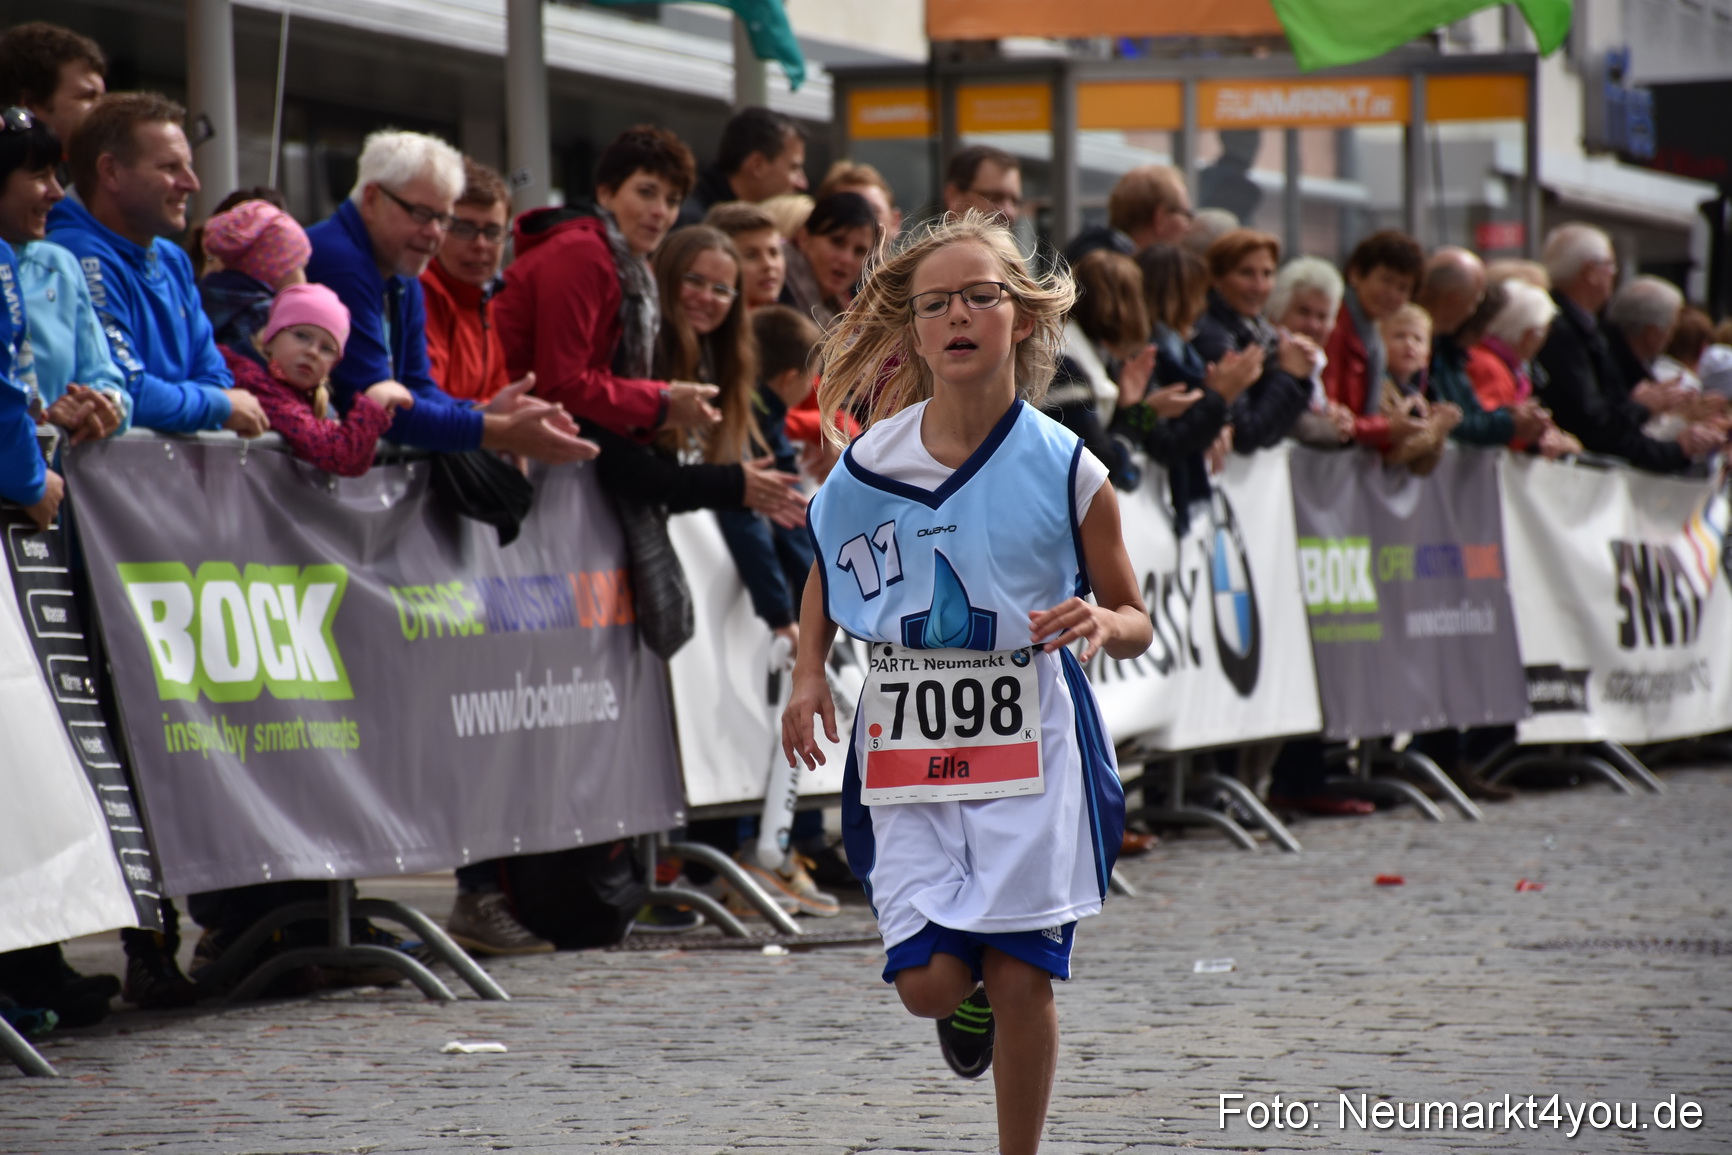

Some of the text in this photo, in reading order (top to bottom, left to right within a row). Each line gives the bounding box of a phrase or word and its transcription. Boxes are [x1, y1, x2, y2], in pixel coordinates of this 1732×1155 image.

[836, 519, 904, 602] 11
[127, 580, 340, 685] BOCK
[870, 654, 1006, 673] PARTL Neumarkt
[881, 675, 1023, 741] 7098
[220, 714, 249, 764] by
[253, 715, 309, 754] smart
[872, 740, 879, 750] 5
[1024, 730, 1032, 739] K
[927, 756, 970, 779] Ella
